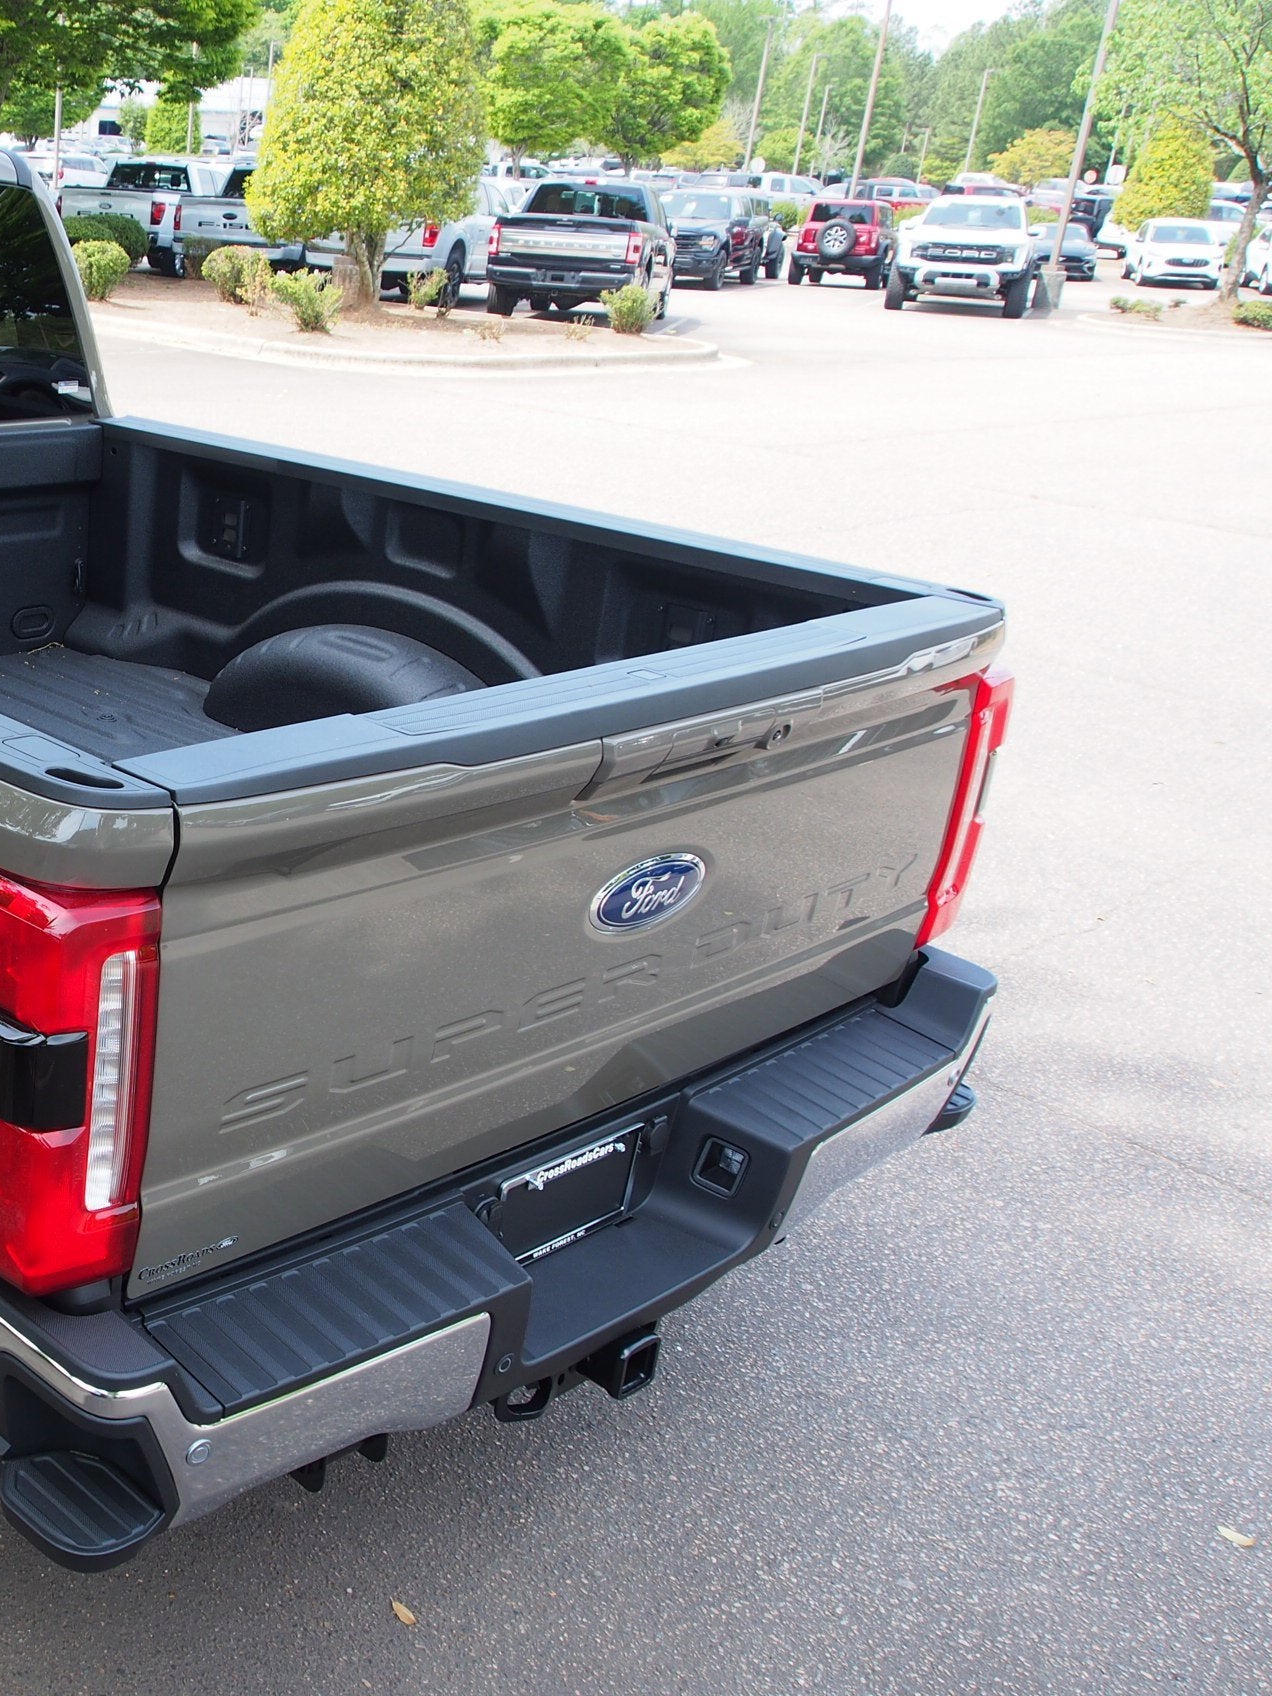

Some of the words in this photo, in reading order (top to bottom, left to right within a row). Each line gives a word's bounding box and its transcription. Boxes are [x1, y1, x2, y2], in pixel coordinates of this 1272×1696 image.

[928, 247, 998, 258] FORD
[621, 871, 685, 919] Ford
[217, 952, 663, 1135] SUPER
[690, 852, 918, 969] DUTY
[532, 1246, 551, 1259] WAKE
